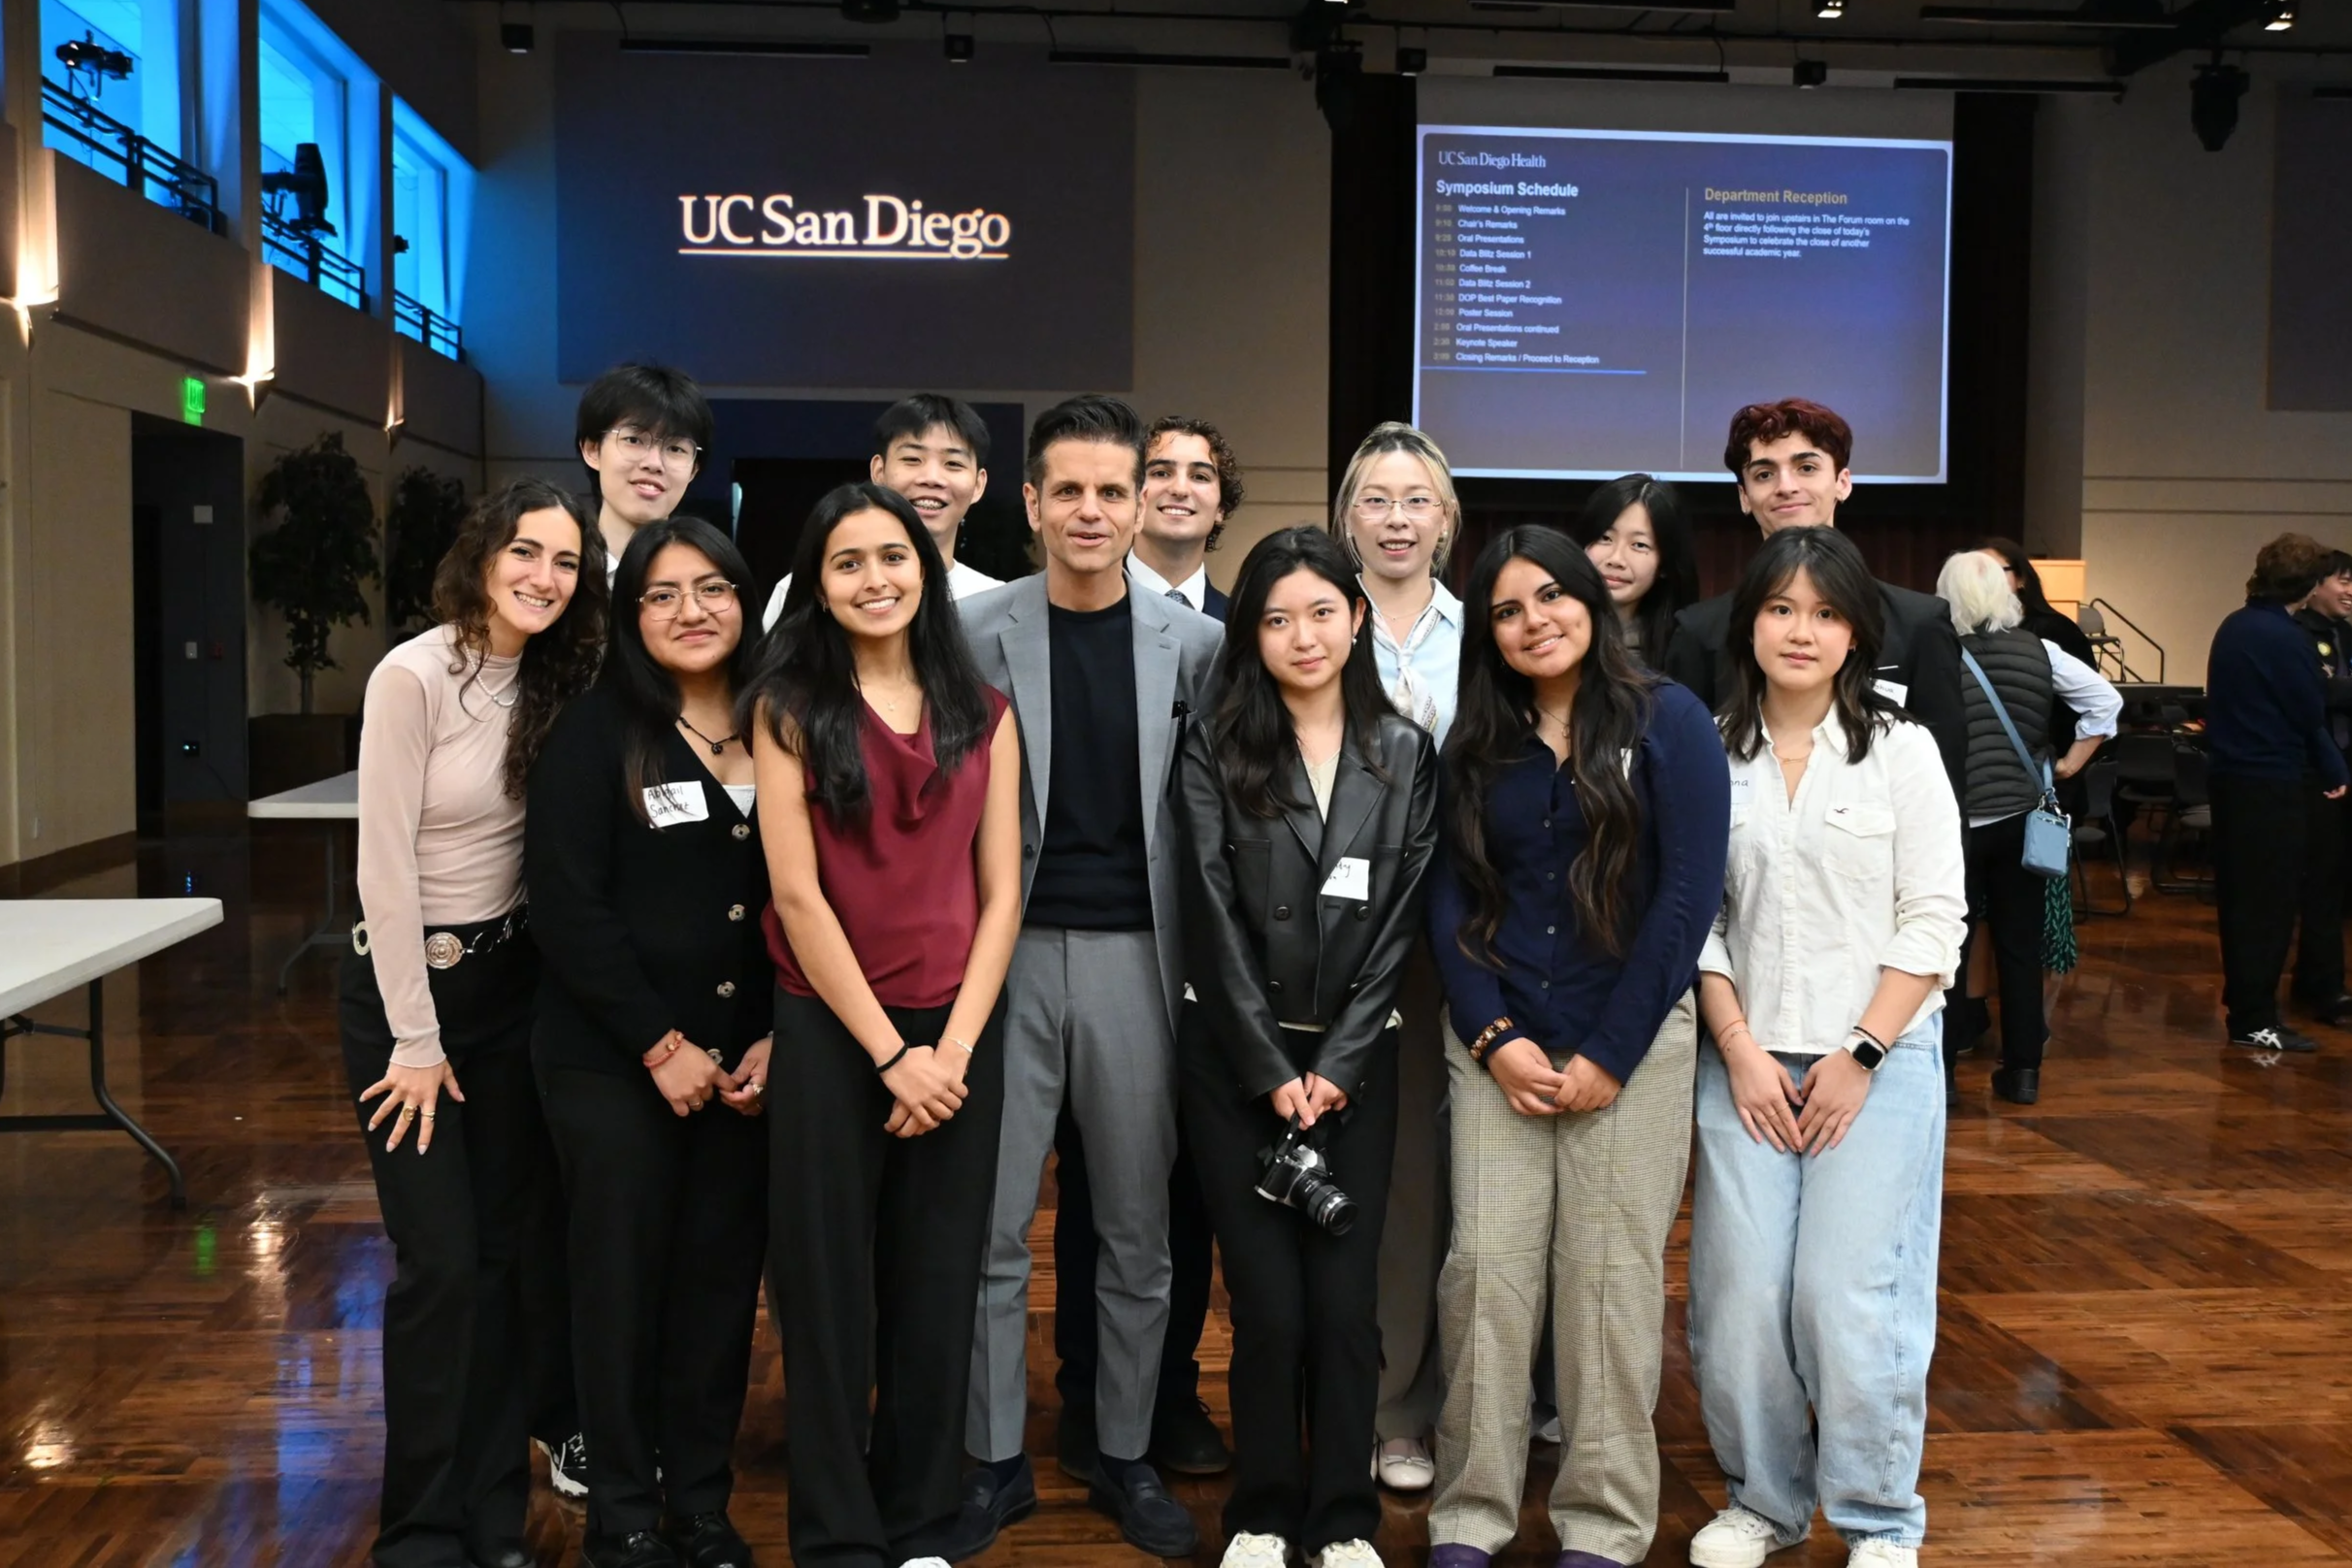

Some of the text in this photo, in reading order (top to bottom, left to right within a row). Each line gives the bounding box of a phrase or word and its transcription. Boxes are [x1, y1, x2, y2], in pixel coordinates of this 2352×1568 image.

[1439, 150, 1547, 169] UC San Diego Health
[1436, 180, 1579, 197] Symposium Schedule
[1705, 187, 1847, 207] Department Reception
[1458, 205, 1492, 213] Welcome
[1493, 205, 1500, 213] &
[1501, 206, 1532, 216] Opening
[1533, 207, 1566, 215] Remarks
[1457, 219, 1484, 229] Chair's
[1485, 220, 1518, 230] Remarks
[1704, 212, 1714, 220] All
[1730, 212, 1755, 221] invited
[1765, 212, 1780, 223] join
[1781, 213, 1812, 224] upstairs
[1813, 213, 1820, 223] in
[1821, 214, 1837, 223] The
[1839, 214, 1863, 224] Forum
[1897, 216, 1910, 226] the
[678, 194, 1011, 260] UC San Diego
[1715, 223, 1732, 232] floor
[1734, 224, 1761, 235] directly
[1763, 224, 1796, 236] following
[1798, 225, 1810, 235] the
[1812, 226, 1832, 235] close
[1834, 226, 1842, 235] of
[1843, 226, 1870, 238] today's
[1457, 234, 1473, 243] Oral
[1475, 235, 1524, 244] Presentations
[1704, 234, 1870, 247] Symposium to celebrate the close of another
[1459, 248, 1478, 258] Data
[1479, 249, 1495, 258] Blitz
[1496, 249, 1525, 259] Session
[1703, 246, 1802, 259] successful academic year.
[1459, 264, 1484, 273] Coffee
[1485, 265, 1506, 274] Break
[1458, 278, 1476, 287] Data
[1478, 279, 1493, 288] Blitz
[1495, 279, 1524, 288] Session
[1458, 294, 1477, 303] DOP
[1478, 294, 1494, 303] Best
[1496, 295, 1518, 305] Paper
[1519, 295, 1562, 306] Recognition
[1458, 309, 1483, 317] Poster
[1484, 309, 1514, 317] Session
[1456, 323, 1472, 332] Oral
[1474, 324, 1522, 333] Presentations
[1524, 325, 1560, 334] continued
[1455, 338, 1486, 348] Keynote
[1487, 339, 1519, 348] Speaker
[1455, 352, 1484, 364] Closing
[1485, 353, 1518, 363] Remarks
[1522, 354, 1553, 363] Proceed
[1554, 355, 1562, 364] to
[1563, 355, 1600, 366] Reception
